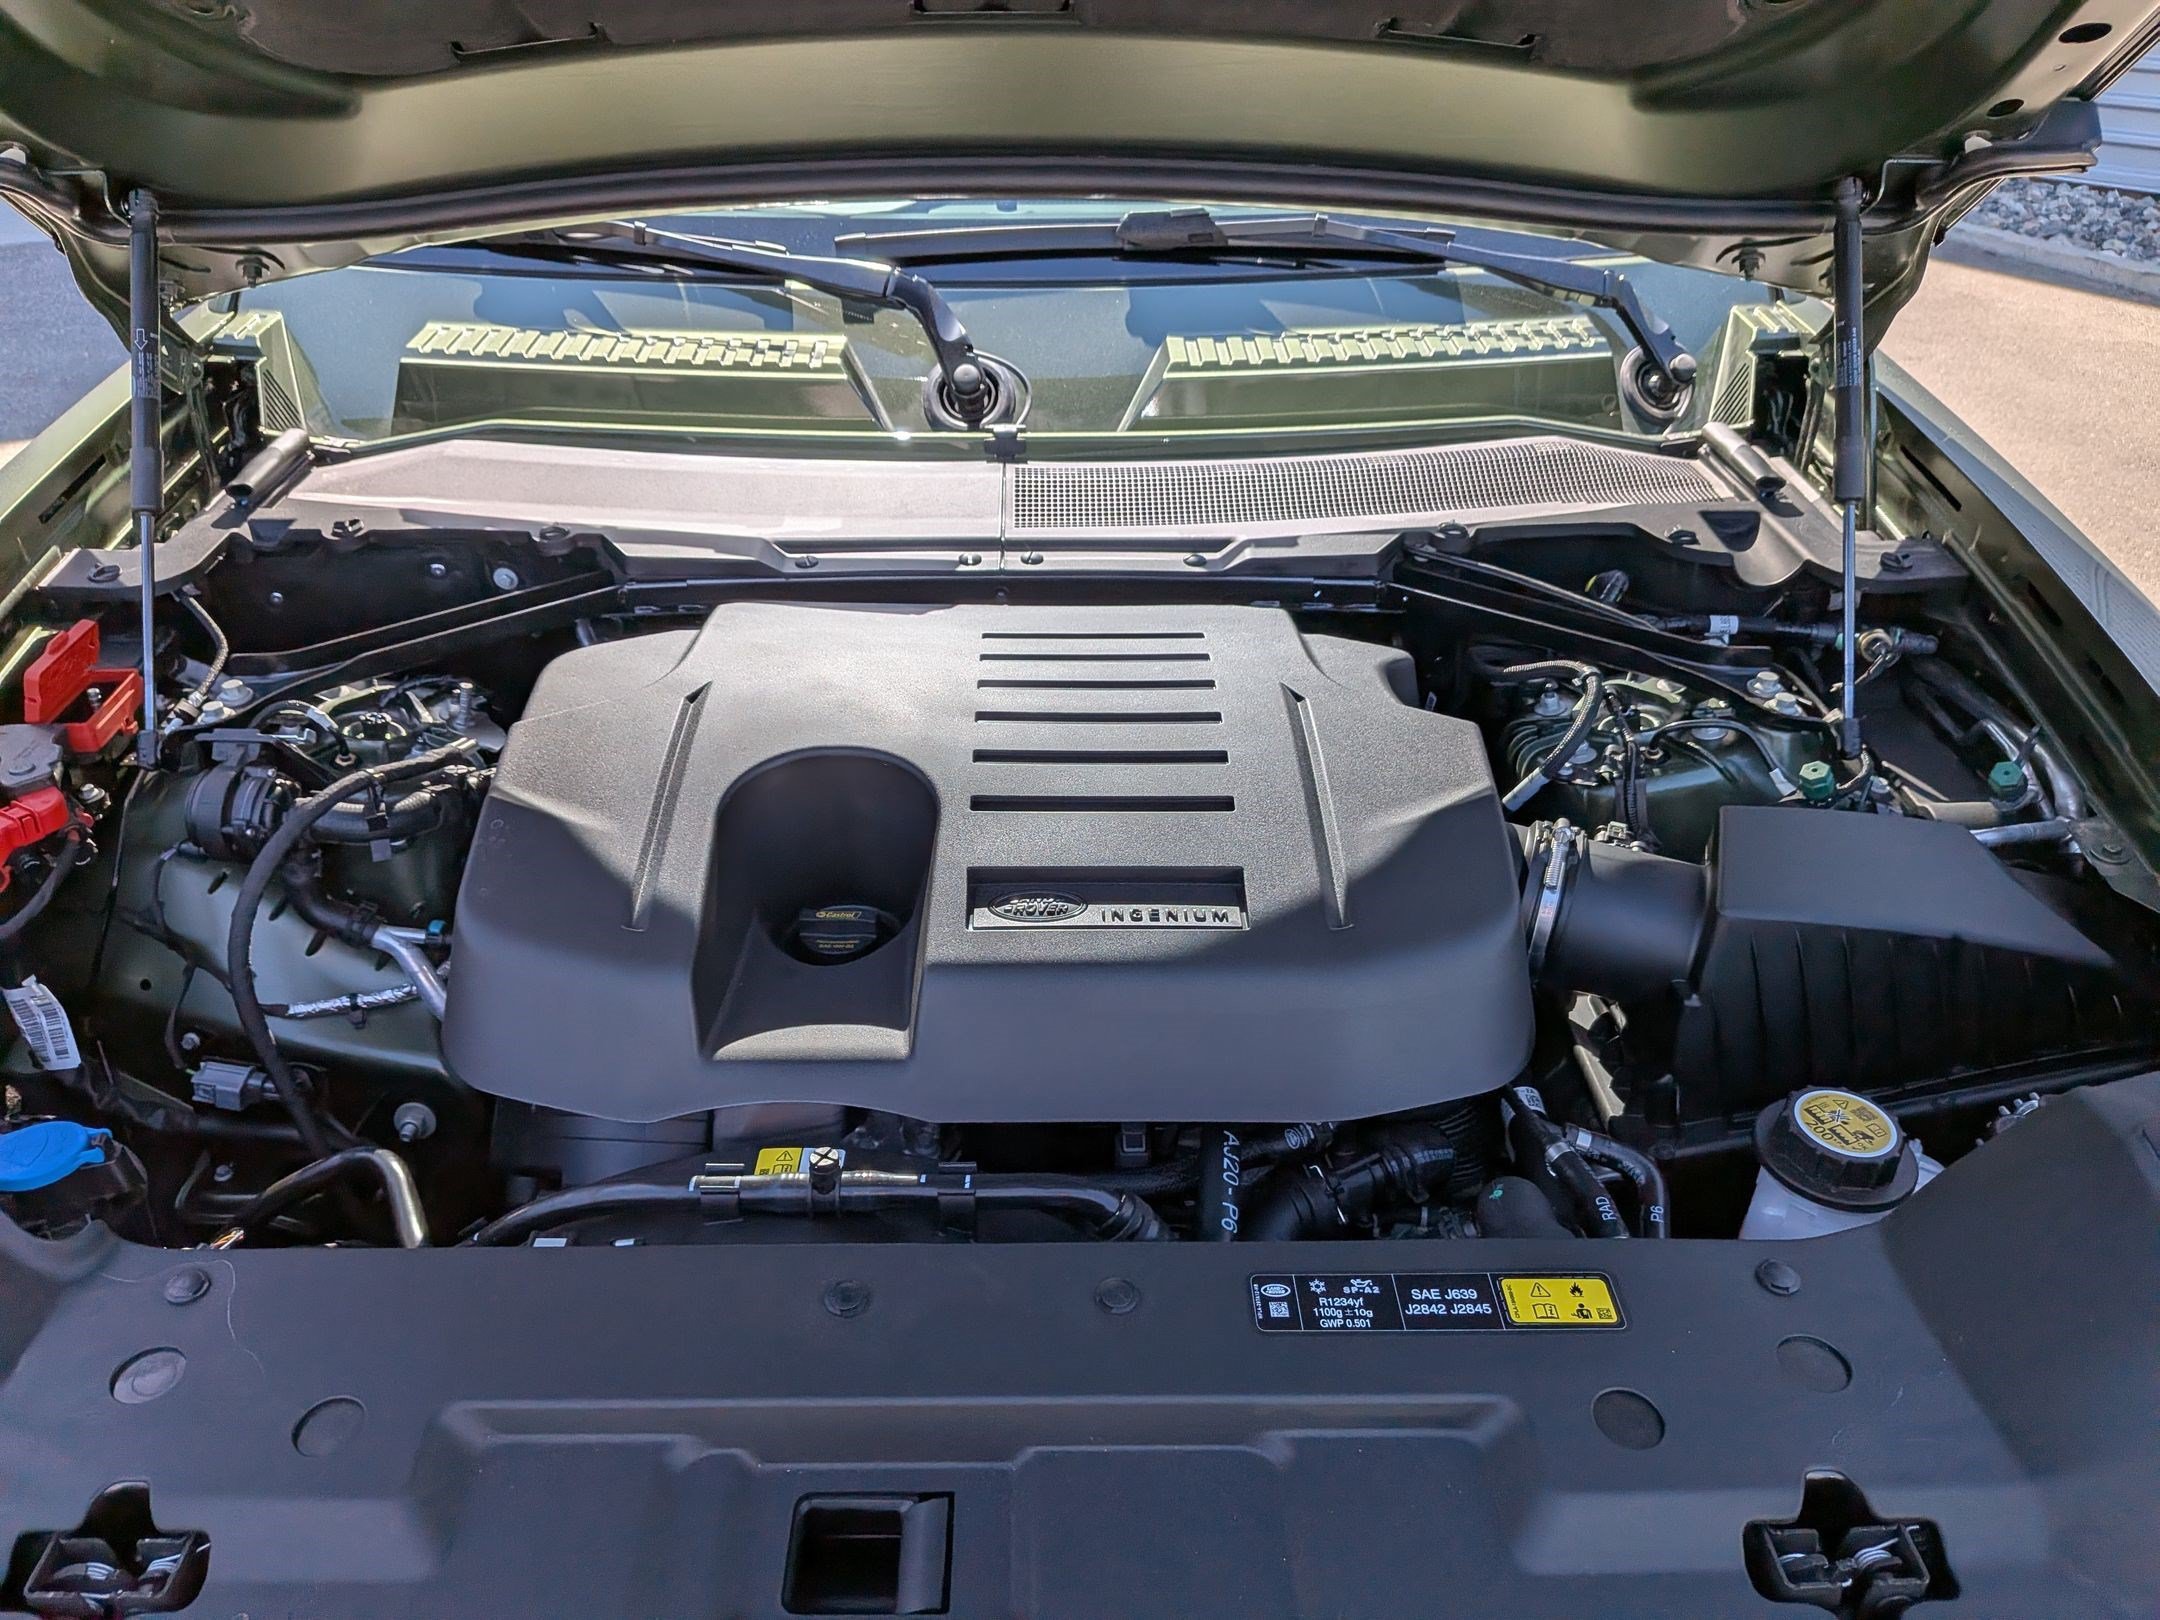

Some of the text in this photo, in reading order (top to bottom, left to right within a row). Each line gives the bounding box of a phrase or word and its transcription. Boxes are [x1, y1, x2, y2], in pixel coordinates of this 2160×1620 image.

[1012, 903, 1069, 916] ROVER
[1101, 908, 1230, 923] INGENIUM
[1805, 1120, 1835, 1141] 200
[1595, 1196, 1617, 1221] RAD
[1650, 1205, 1664, 1223] P6
[1343, 1286, 1380, 1294] SP-A2
[1411, 1288, 1478, 1300] SAE J639
[1319, 1297, 1364, 1308] R1234yf
[1313, 1308, 1343, 1318] 1100g
[1405, 1303, 1493, 1315] J2842 J2845
[1320, 1319, 1371, 1328] GWP 0.501
